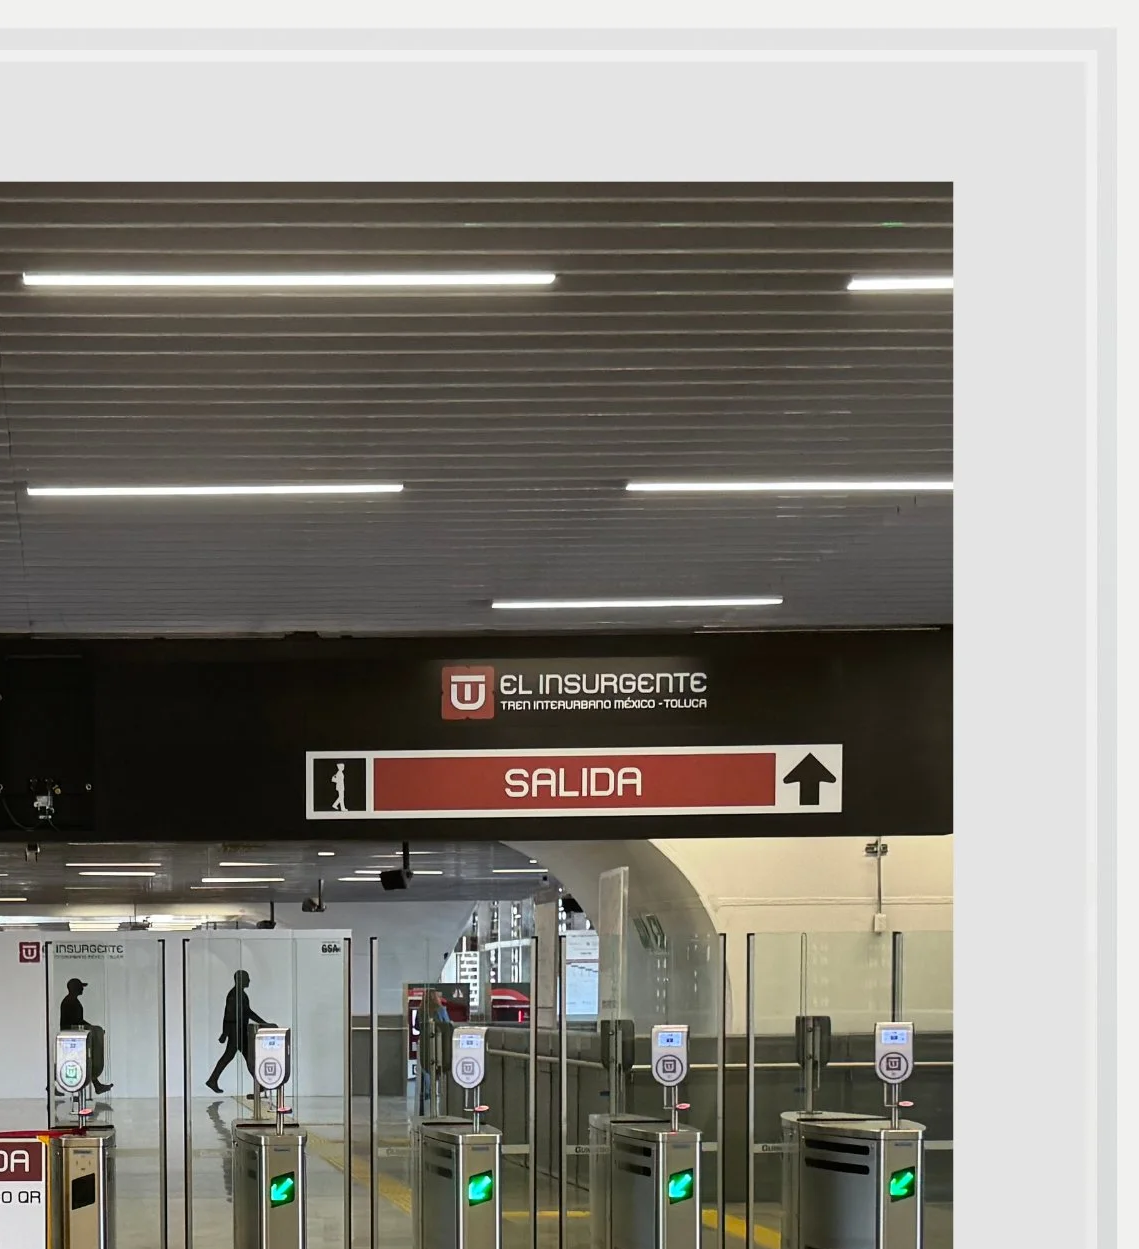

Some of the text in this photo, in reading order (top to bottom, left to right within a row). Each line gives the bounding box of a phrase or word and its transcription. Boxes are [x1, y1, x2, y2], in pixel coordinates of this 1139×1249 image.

[500, 672, 708, 696] EL INSURGENTE
[500, 700, 532, 711] TREN
[533, 699, 612, 711] INTERURBANO
[614, 696, 656, 710] MÉXICO
[504, 766, 643, 798] SALIDA
[18, 1190, 42, 1204] QR
